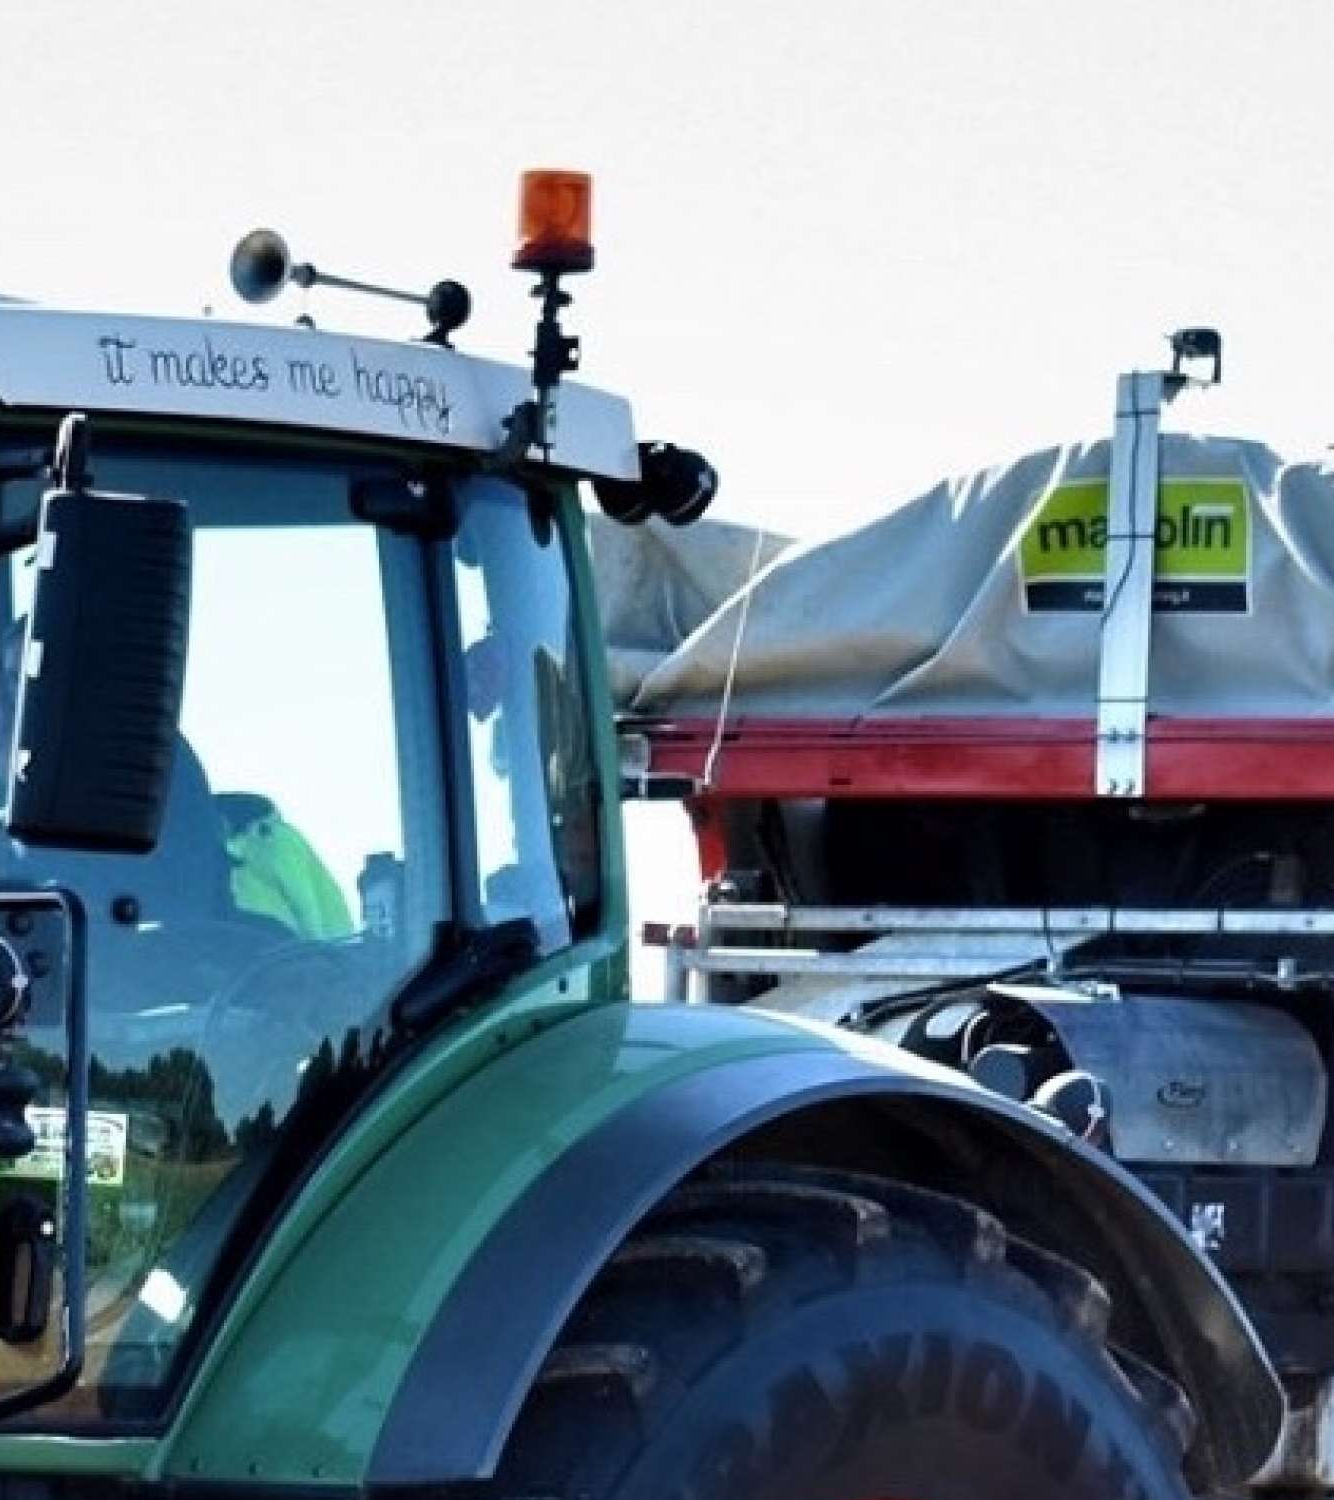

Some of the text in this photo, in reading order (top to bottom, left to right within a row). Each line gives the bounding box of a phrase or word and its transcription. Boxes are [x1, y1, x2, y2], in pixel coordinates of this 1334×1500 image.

[98, 333, 451, 435] it makes me happy
